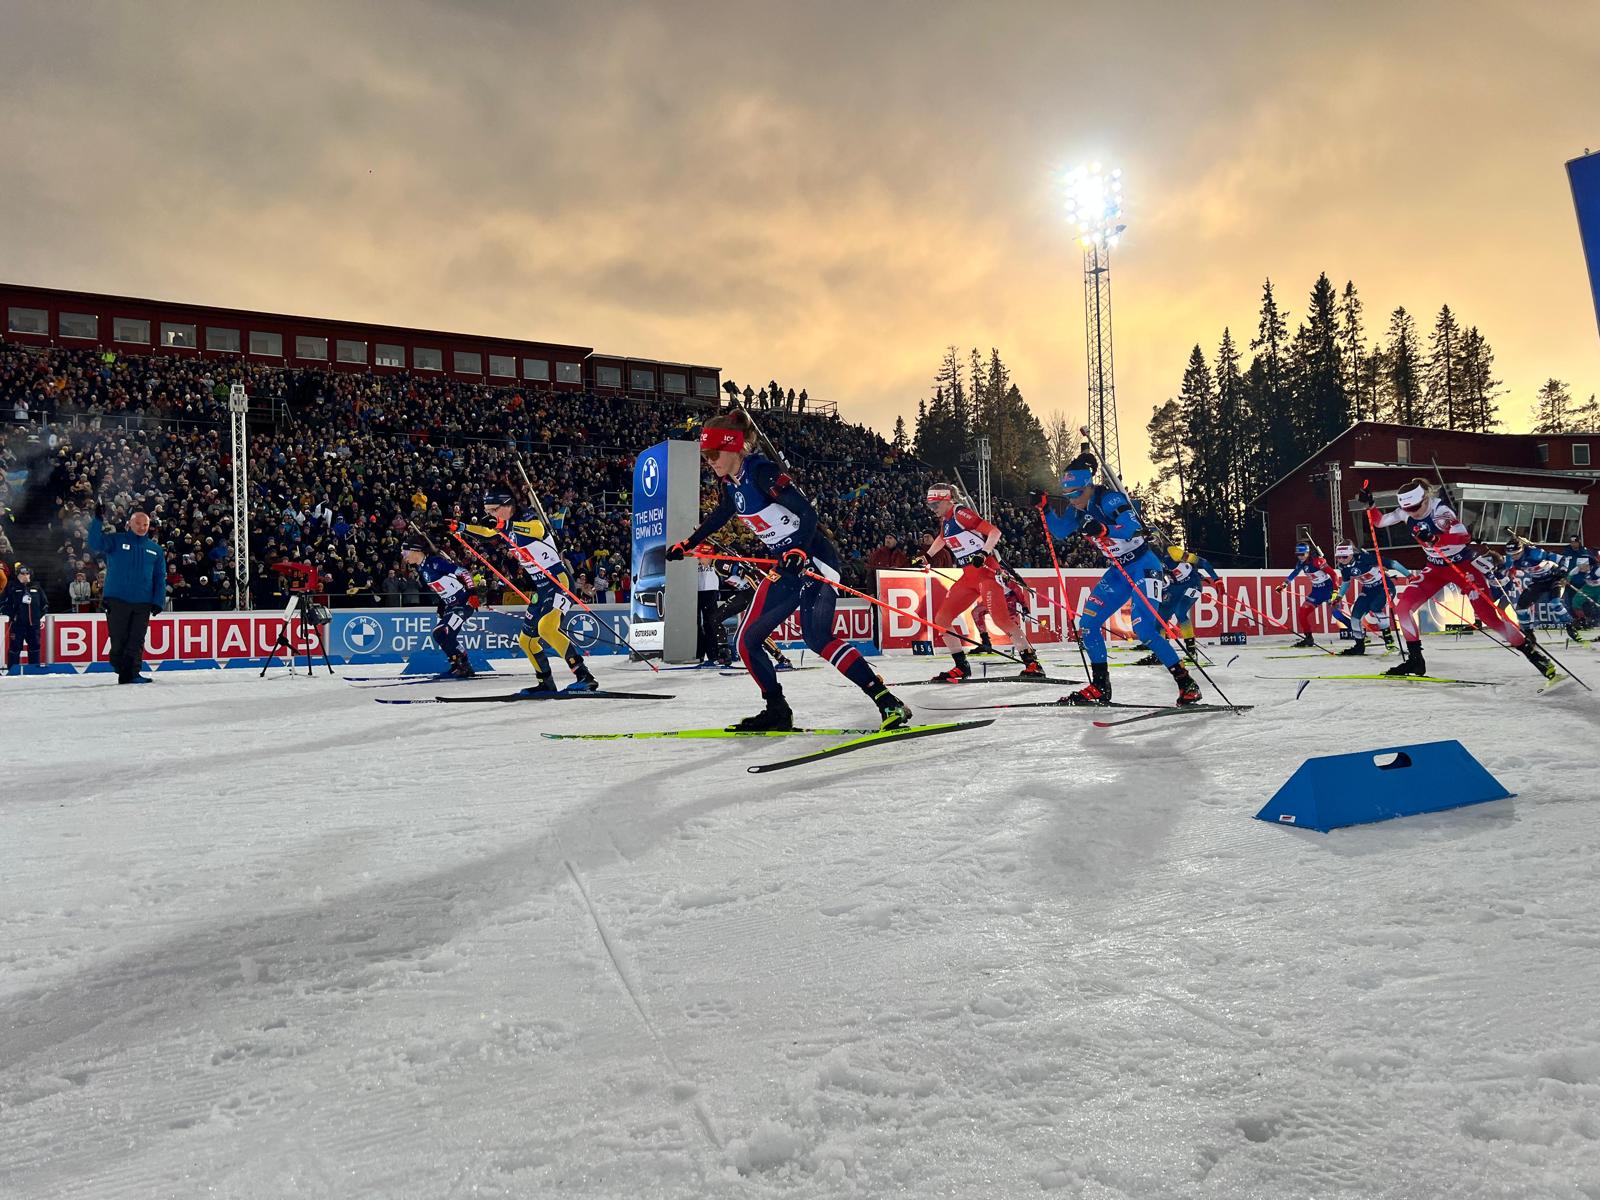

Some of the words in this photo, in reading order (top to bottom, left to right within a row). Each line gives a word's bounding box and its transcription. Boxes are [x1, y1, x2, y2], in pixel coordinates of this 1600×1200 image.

[634, 511, 648, 525] THE
[648, 507, 664, 522] NEW
[781, 515, 790, 525] 3
[635, 525, 651, 540] BMW
[541, 551, 550, 560] 2
[1153, 581, 1159, 599] 6
[1189, 589, 1196, 598] 8
[559, 597, 567, 611] 2
[391, 617, 431, 632] THE
[59, 622, 319, 657] BUHAUS
[392, 636, 418, 651] OF
[420, 636, 435, 650] A
[1238, 634, 1246, 642] 12
